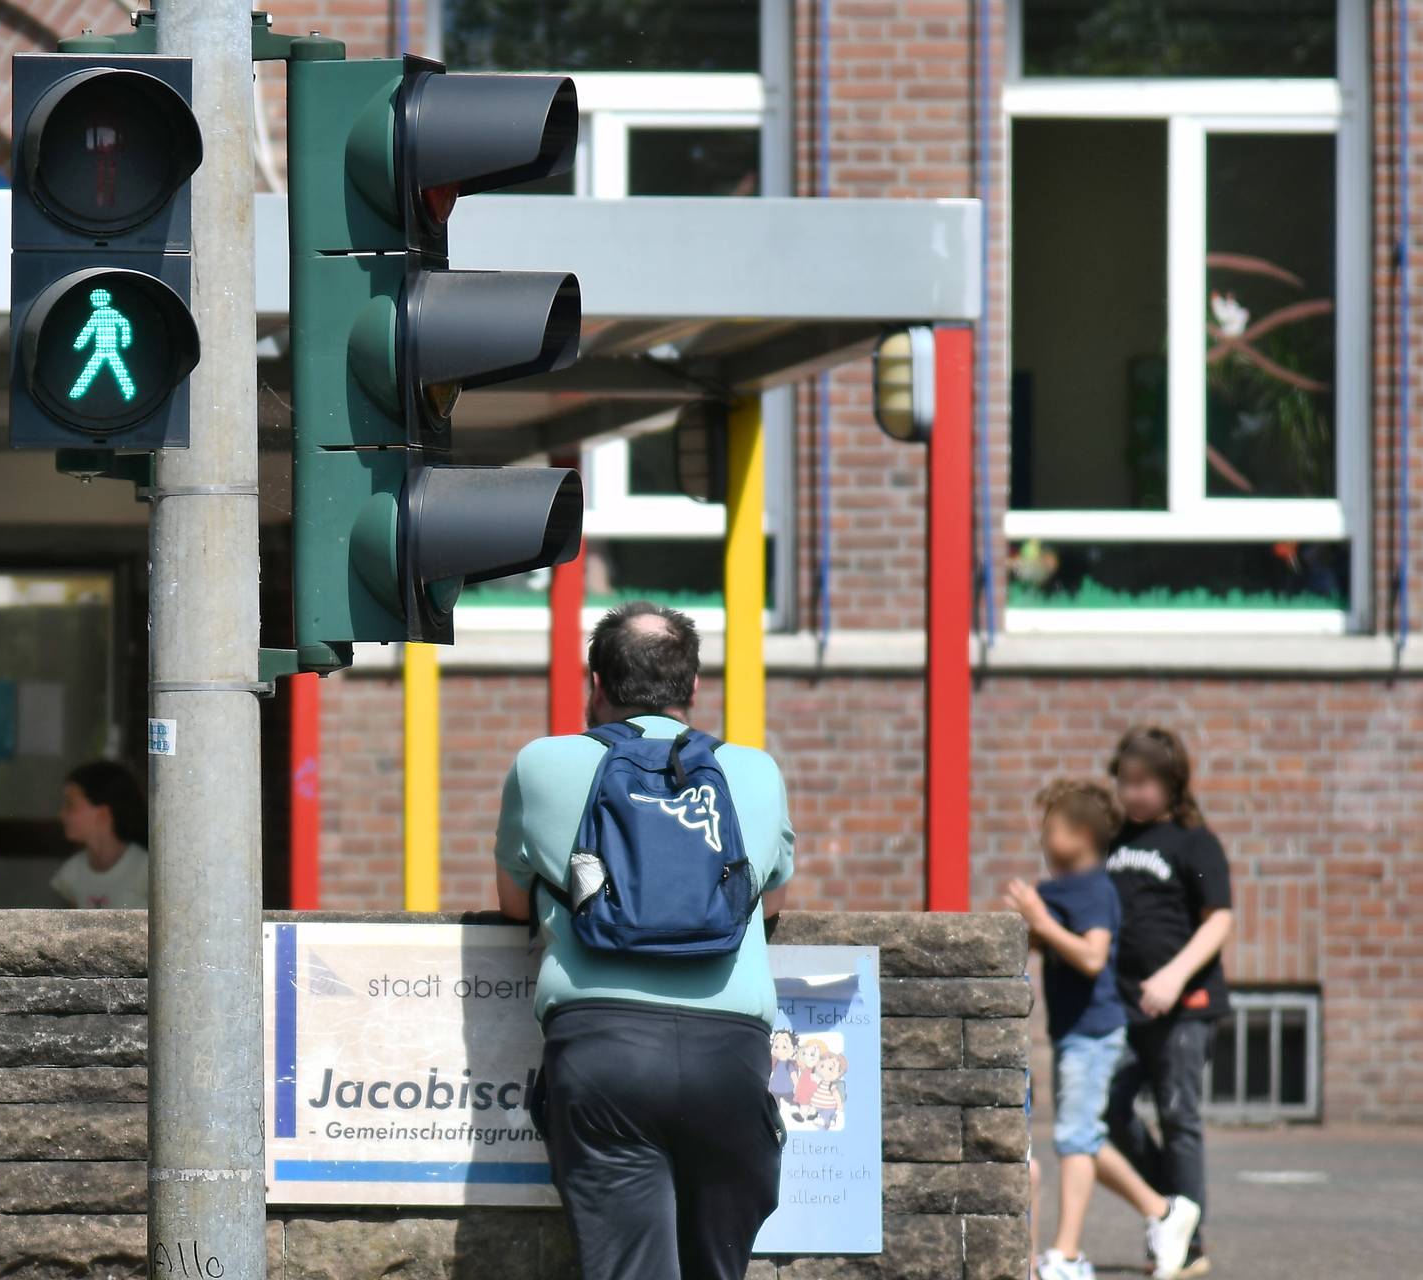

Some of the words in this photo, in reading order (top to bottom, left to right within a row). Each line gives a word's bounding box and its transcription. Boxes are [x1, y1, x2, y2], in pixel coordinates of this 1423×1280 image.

[368, 974, 442, 998] stadt
[849, 1162, 872, 1180] ich
[787, 1187, 847, 1205] alleine!
